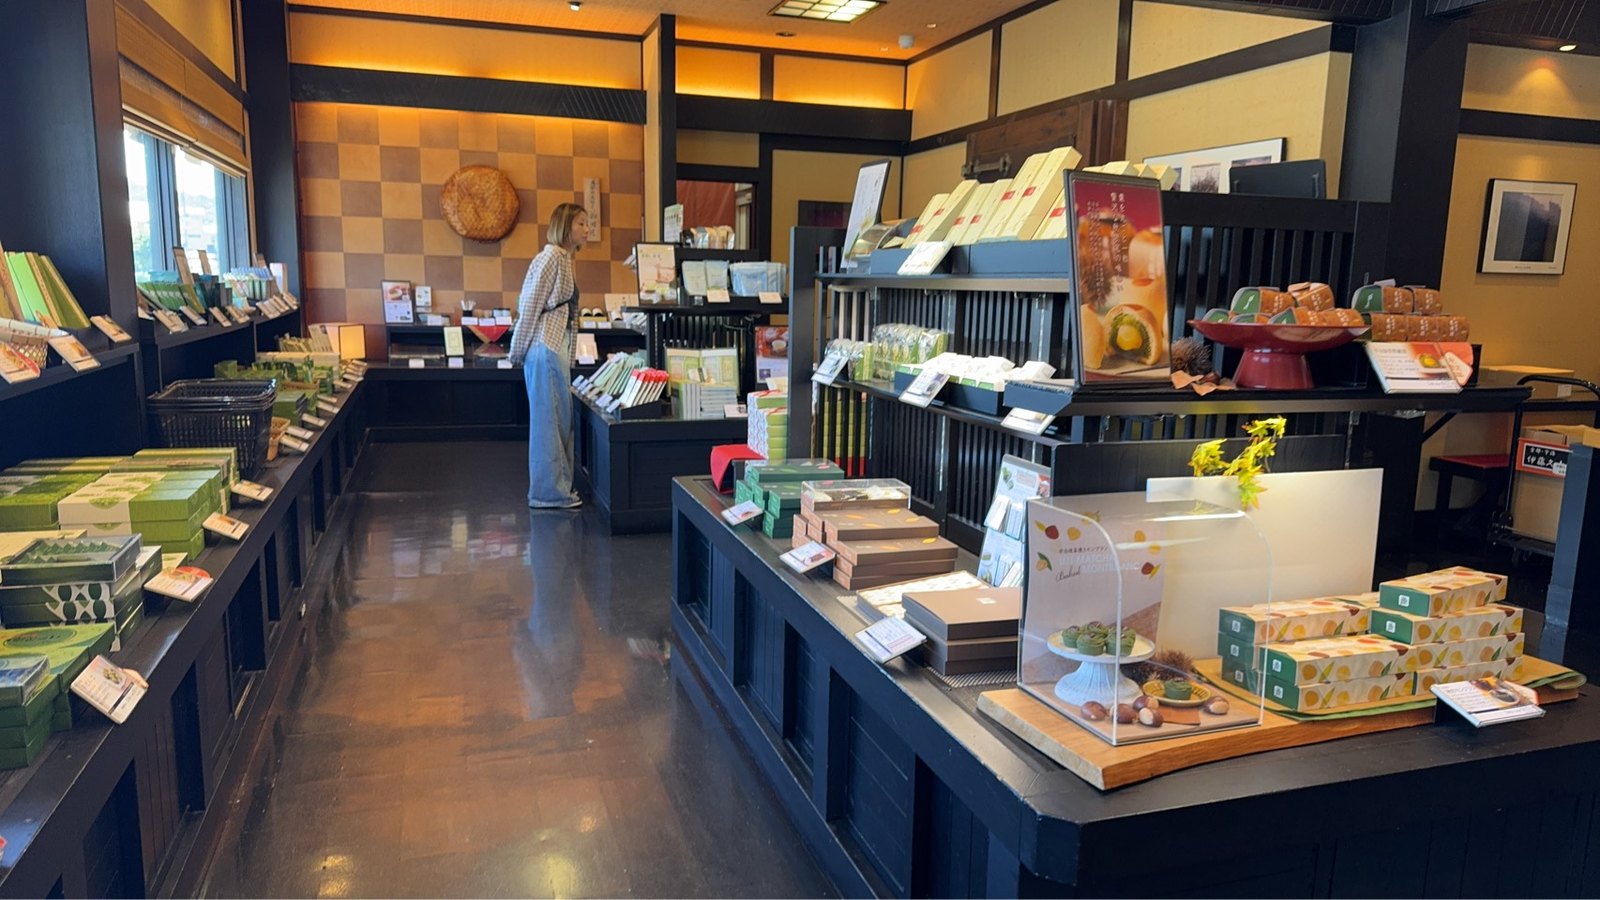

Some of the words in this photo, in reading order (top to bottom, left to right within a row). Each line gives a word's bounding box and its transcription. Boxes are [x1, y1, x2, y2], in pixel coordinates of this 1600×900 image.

[1530, 447, 1556, 456] 京都・宇治
